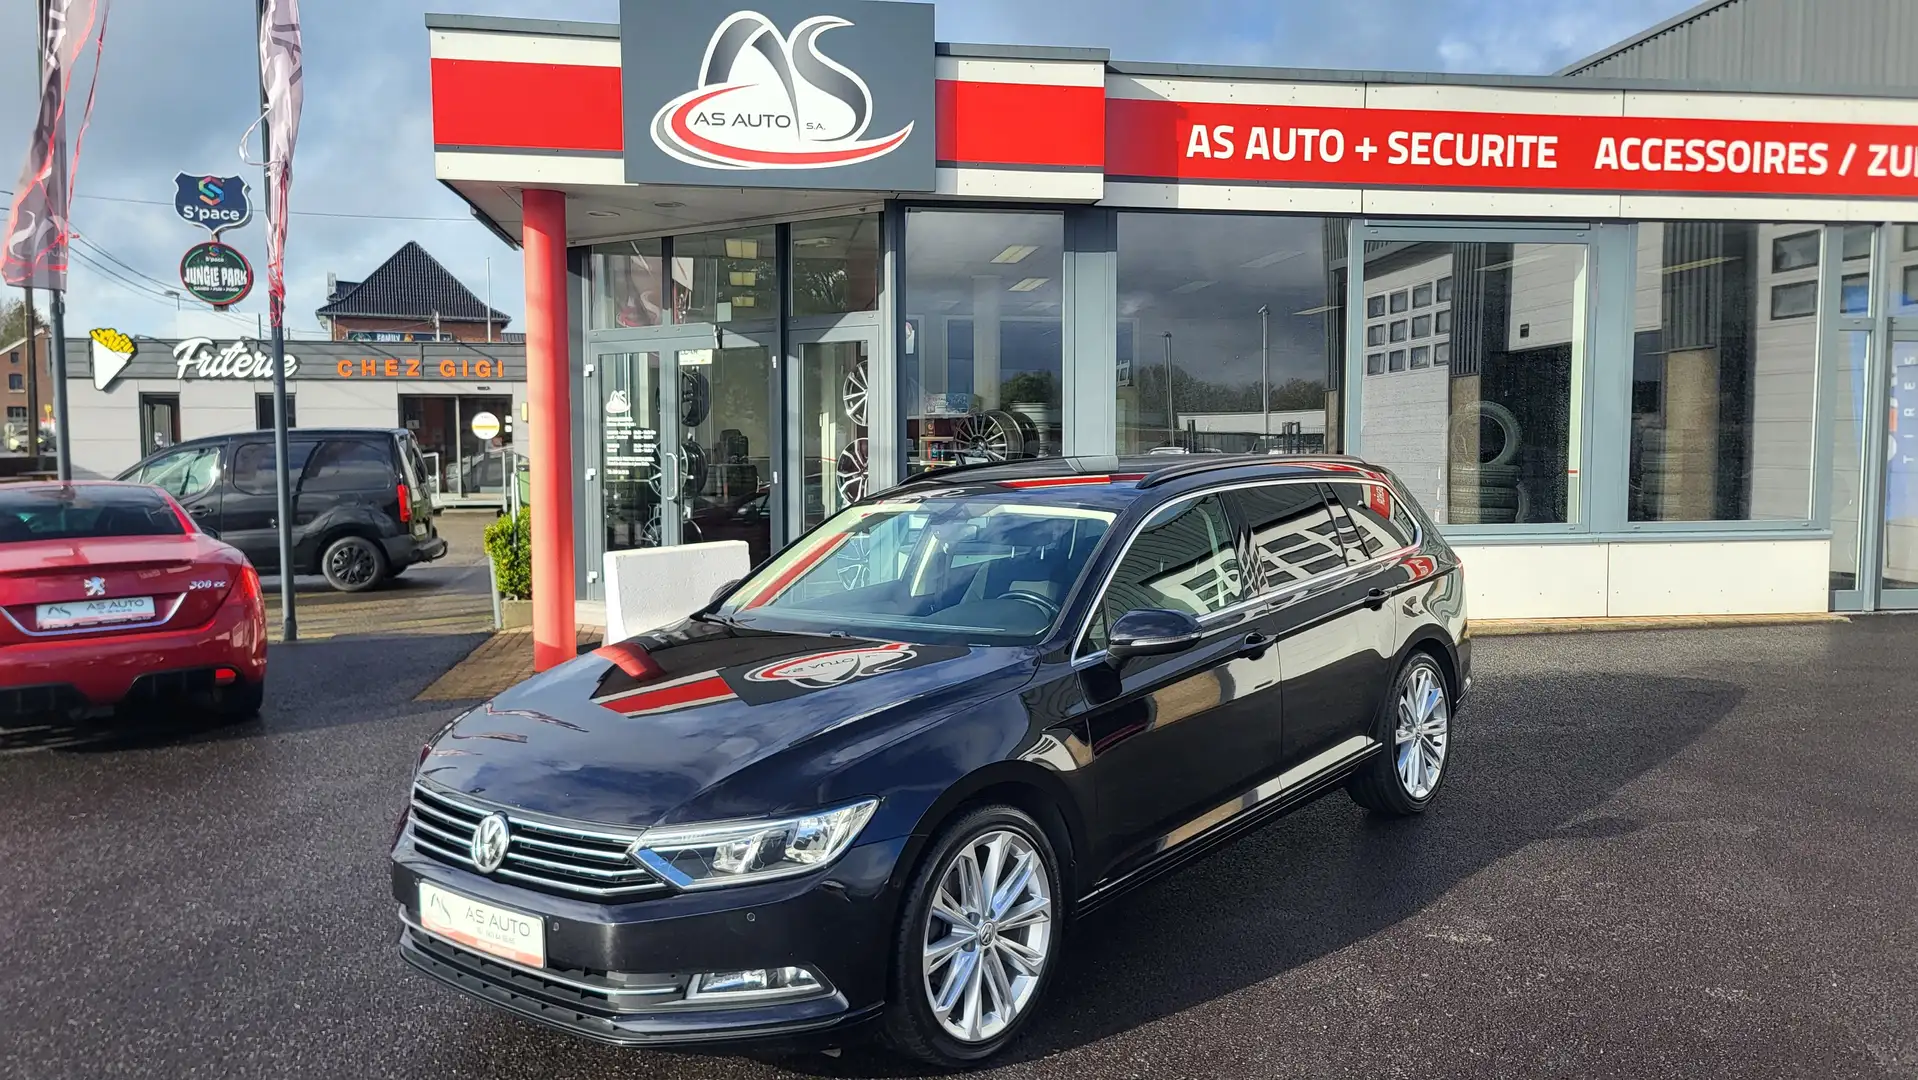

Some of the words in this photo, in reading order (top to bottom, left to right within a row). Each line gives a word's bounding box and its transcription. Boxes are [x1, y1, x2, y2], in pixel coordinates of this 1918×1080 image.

[694, 111, 726, 126] AS
[731, 113, 791, 129] AUTO
[806, 122, 826, 130] S.A.
[1185, 123, 1235, 160] AS
[1245, 126, 1345, 163] AUTO
[1387, 130, 1559, 169] SECURITE
[1594, 136, 1829, 176] ACCESSOIRES
[183, 205, 240, 221] S'pace
[184, 265, 220, 287] JUNGLE
[220, 267, 248, 287] PARK
[336, 359, 421, 377] CHEZ
[439, 359, 504, 378] GIGI
[189, 579, 211, 590] 308
[109, 598, 145, 610] AUTO
[465, 905, 485, 924] AS
[488, 913, 531, 937] AUTO
